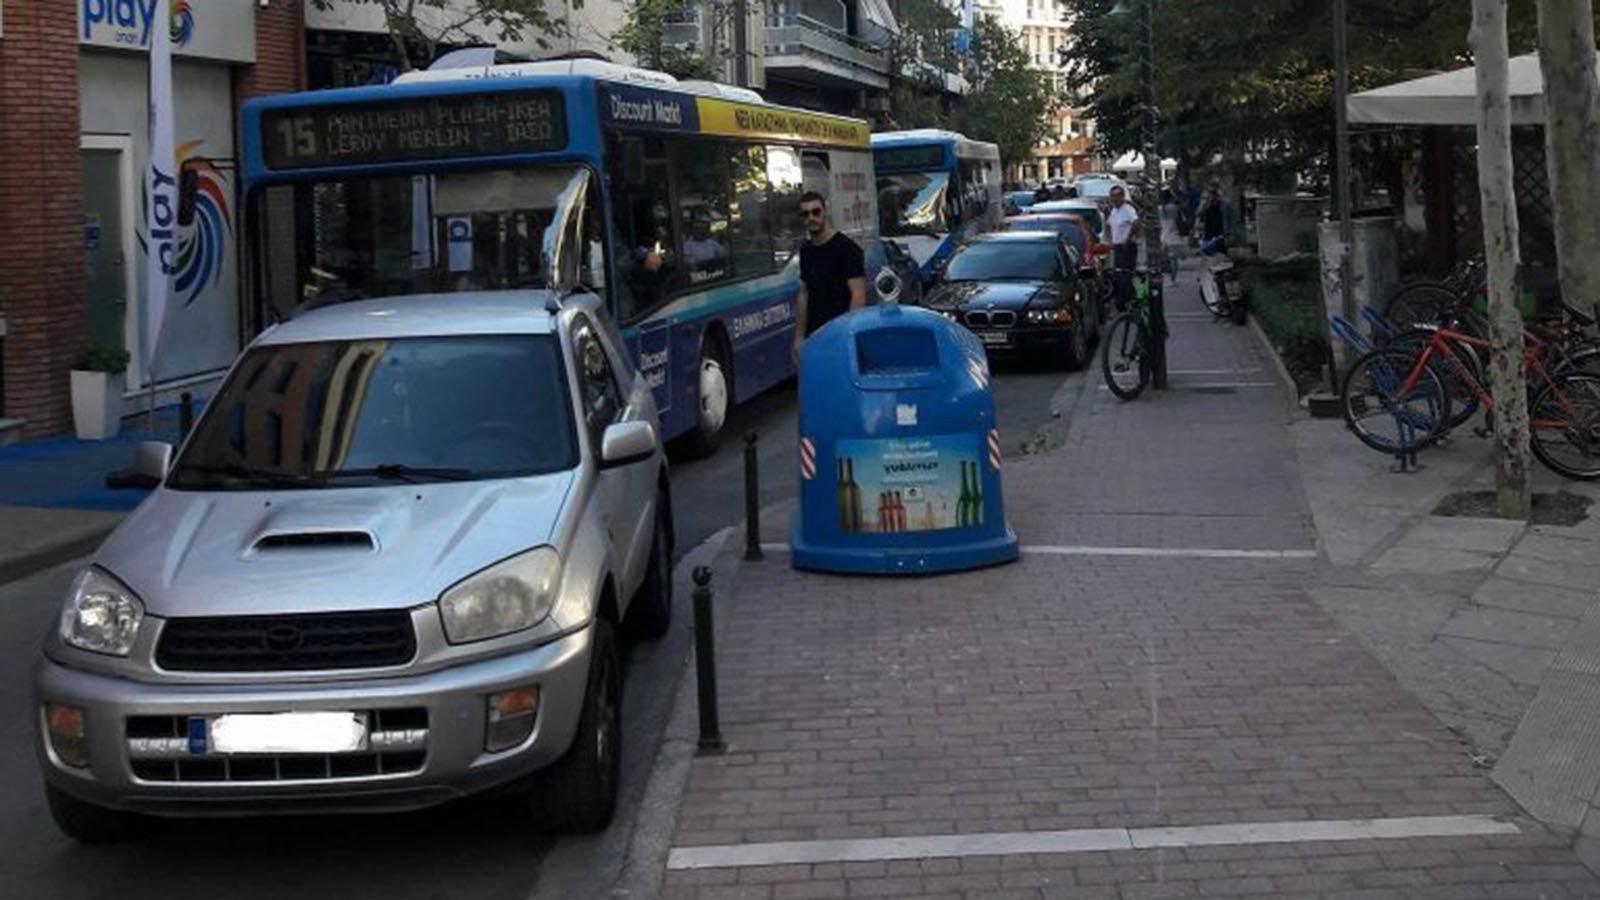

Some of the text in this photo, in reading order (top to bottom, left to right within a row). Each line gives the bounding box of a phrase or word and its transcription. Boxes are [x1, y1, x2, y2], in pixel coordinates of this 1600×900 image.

[83, 0, 158, 46] play
[610, 93, 682, 124] Discount Markt
[276, 117, 317, 157] 15
[327, 132, 386, 154] LEROY
[399, 126, 471, 148] MERLIN
[150, 163, 177, 275] play
